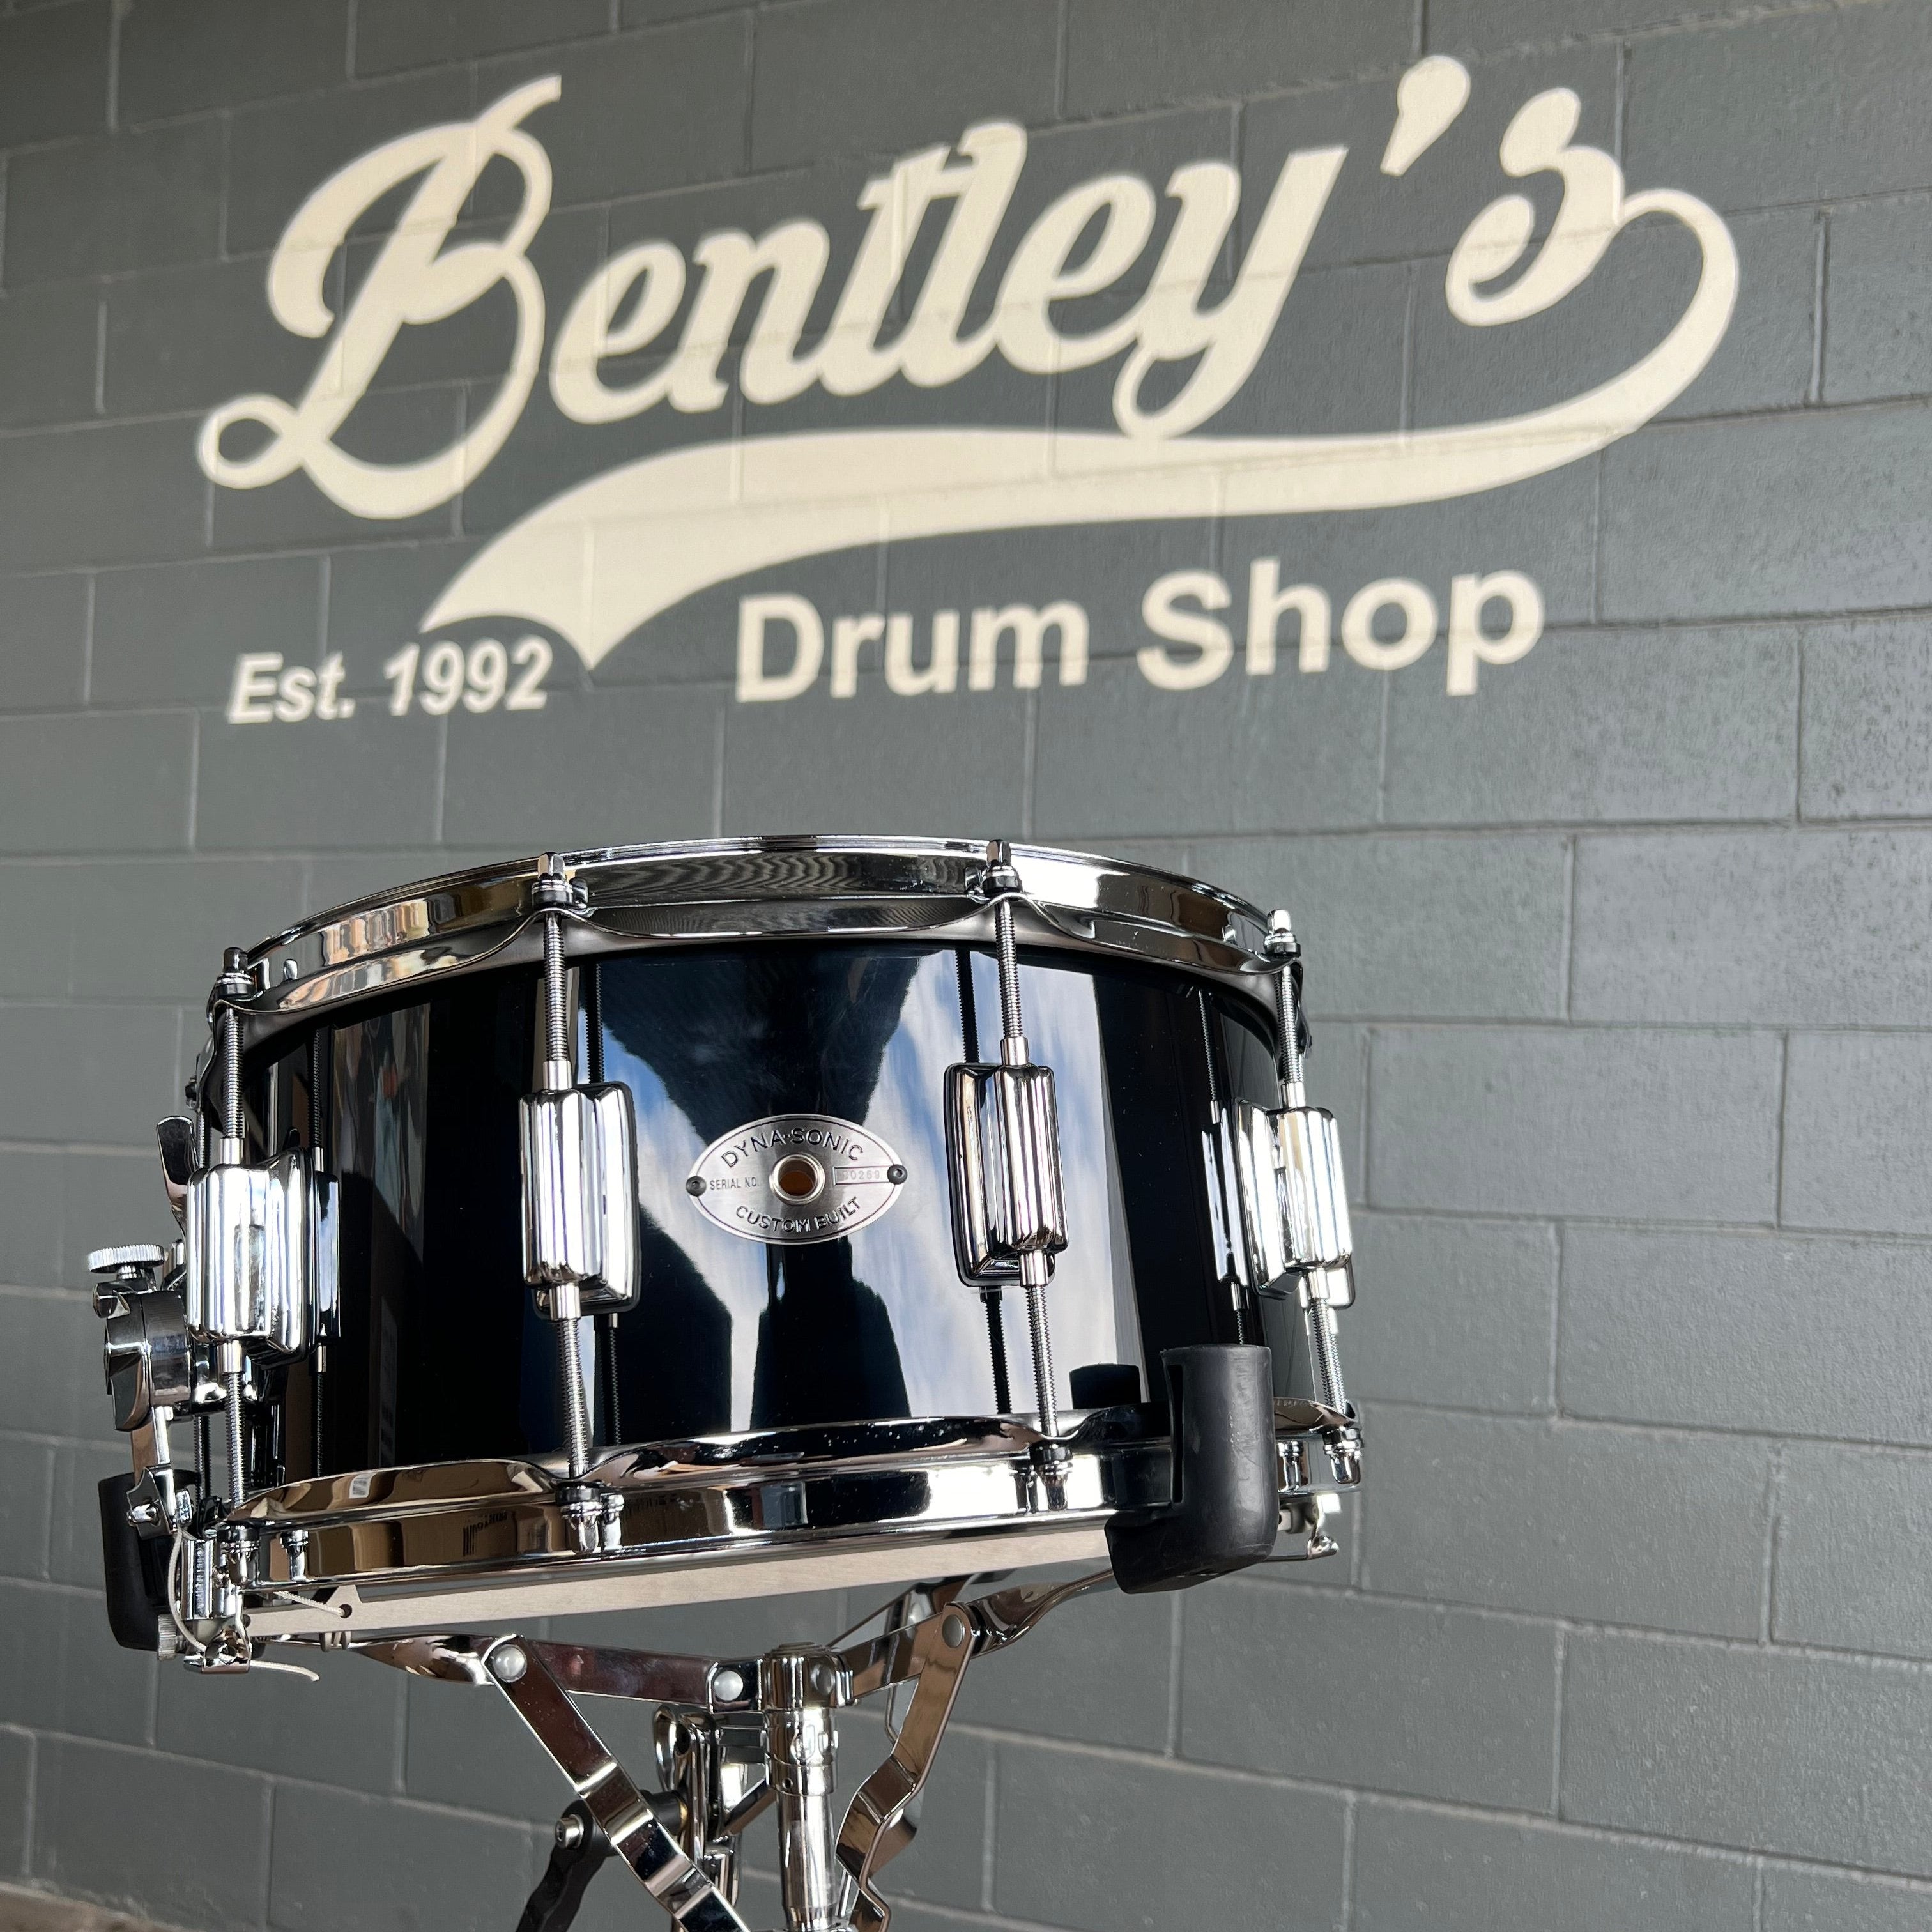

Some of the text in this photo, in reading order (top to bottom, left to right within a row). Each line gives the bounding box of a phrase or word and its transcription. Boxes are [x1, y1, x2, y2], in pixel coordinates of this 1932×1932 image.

[198, 55, 1739, 519] Bentley's
[735, 558, 1545, 703] Drum Shop
[227, 636, 553, 724] Est. 1992
[710, 1178, 741, 1190] SERIAL
[736, 1196, 861, 1233] CUSTOM BUILT
